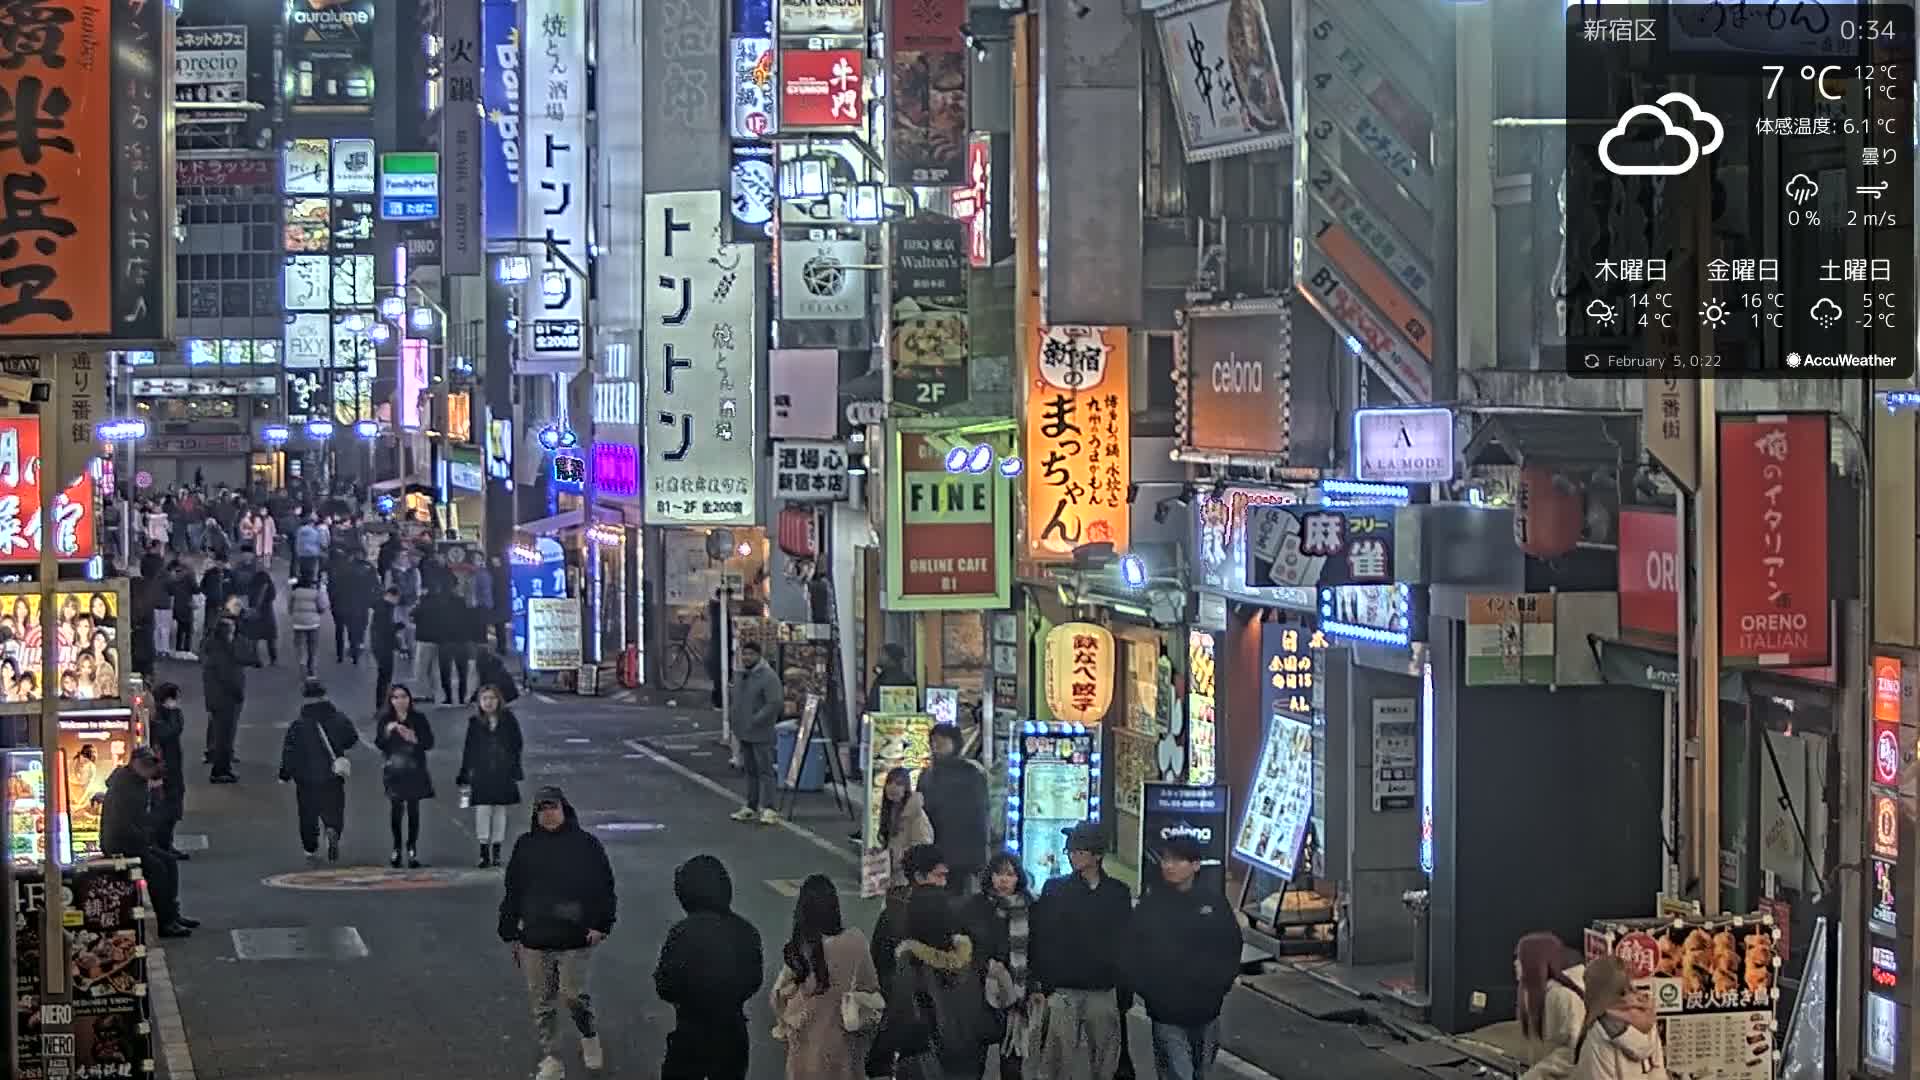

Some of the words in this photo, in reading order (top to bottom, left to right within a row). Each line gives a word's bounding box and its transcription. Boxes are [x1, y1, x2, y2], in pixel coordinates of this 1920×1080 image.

[1313, 20, 1333, 40] 5
[829, 57, 859, 120] 牛門
[1313, 72, 1333, 89] 4
[1313, 119, 1333, 140] 3
[386, 178, 435, 192] FamilyMart
[1312, 169, 1333, 192] 2
[1315, 220, 1333, 238] 1
[903, 239, 928, 250] BBQ
[1311, 267, 1340, 297] B1
[659, 207, 693, 460] トントン
[1043, 336, 1101, 372] 新宿
[1212, 352, 1263, 393] celona
[71, 352, 91, 443] 通り一番街
[917, 384, 946, 402] 2F
[779, 448, 843, 470] 酒場心
[1041, 394, 1085, 543] まっちゃん
[1402, 458, 1443, 469] MODE
[778, 474, 843, 492] 新宿本店
[910, 483, 986, 513] FINE
[1348, 517, 1388, 533] フリー
[1754, 429, 1788, 601] 俺のイタリアン
[1304, 513, 1386, 578] 麻雀
[910, 559, 953, 573] ONLINE
[958, 558, 988, 572] CAFE
[1741, 614, 1807, 632] ORENO
[1740, 634, 1808, 649] ITALIAN
[1072, 634, 1098, 712] 鉄なべ餃子
[1686, 989, 1770, 1009] 炭火焼き鳥
[41, 1004, 72, 1024] NERO
